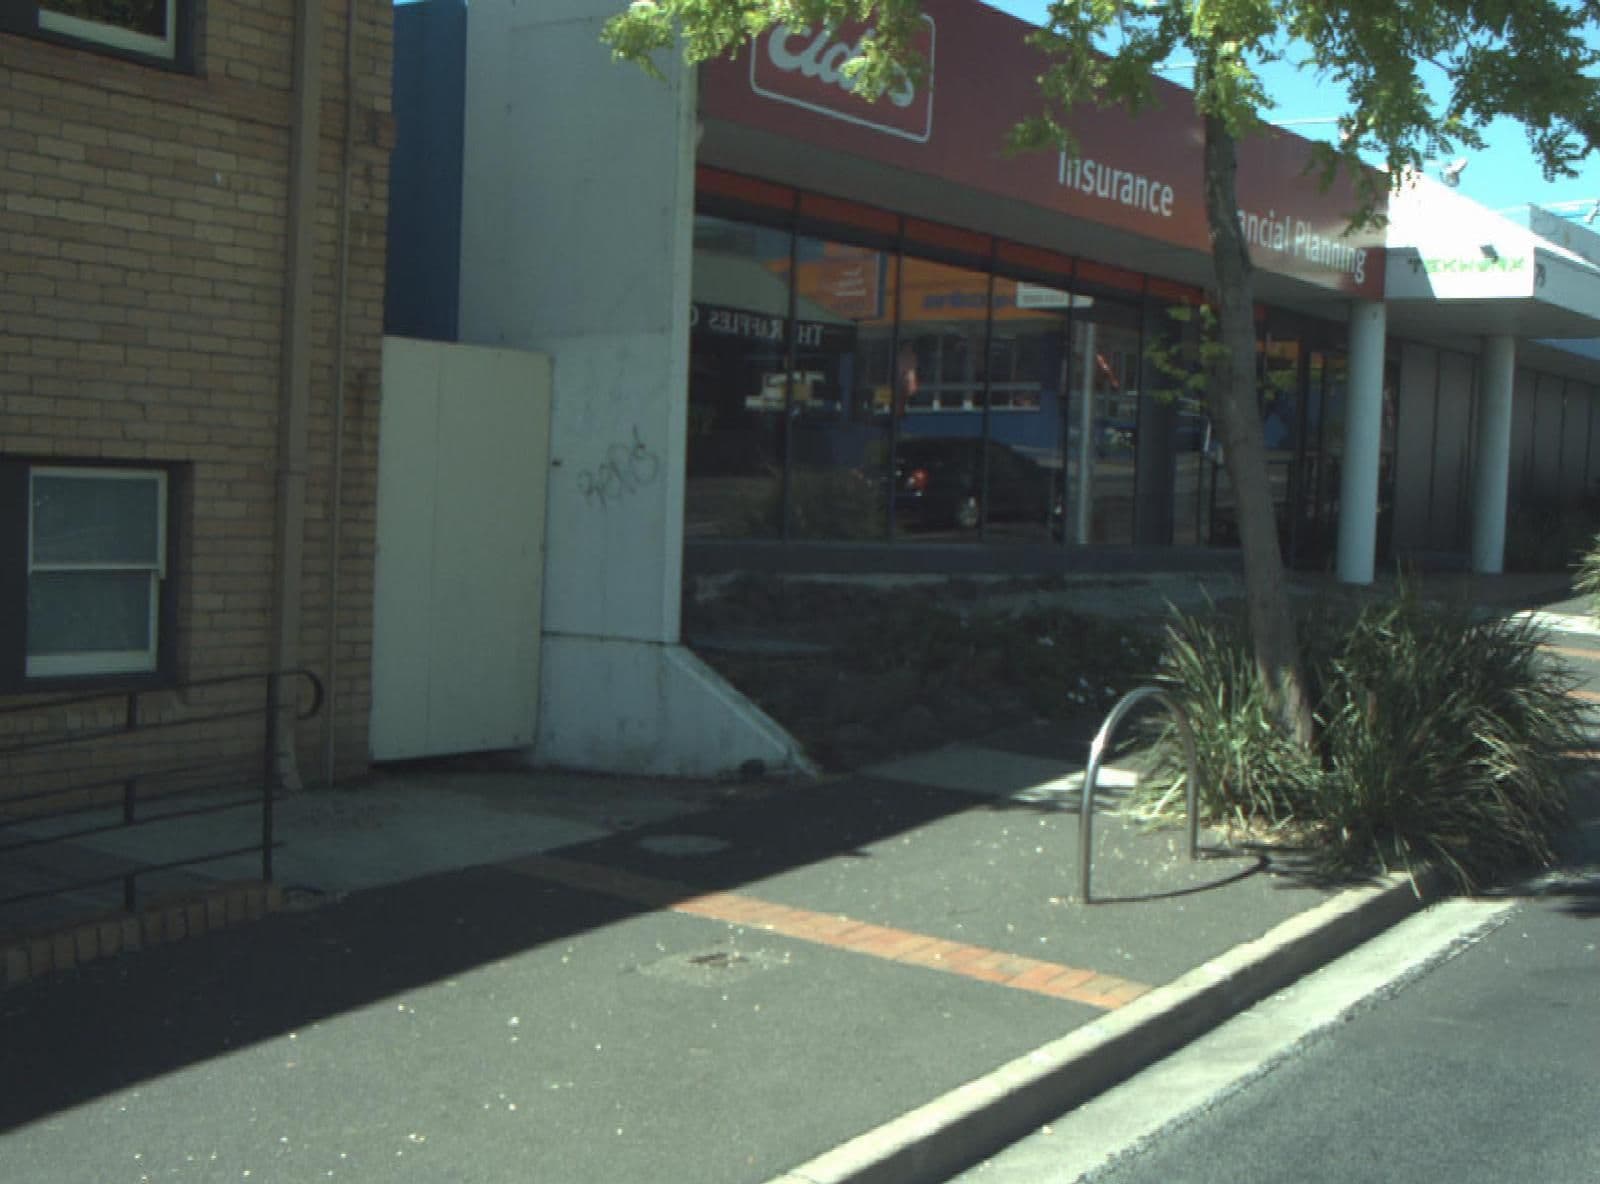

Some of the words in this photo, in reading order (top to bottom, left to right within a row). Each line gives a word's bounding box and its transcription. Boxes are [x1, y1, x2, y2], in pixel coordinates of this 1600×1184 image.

[768, 13, 914, 107] Elds
[1058, 148, 1174, 217] Insurance
[1210, 207, 1291, 254] ancial
[1294, 219, 1367, 285] Planning
